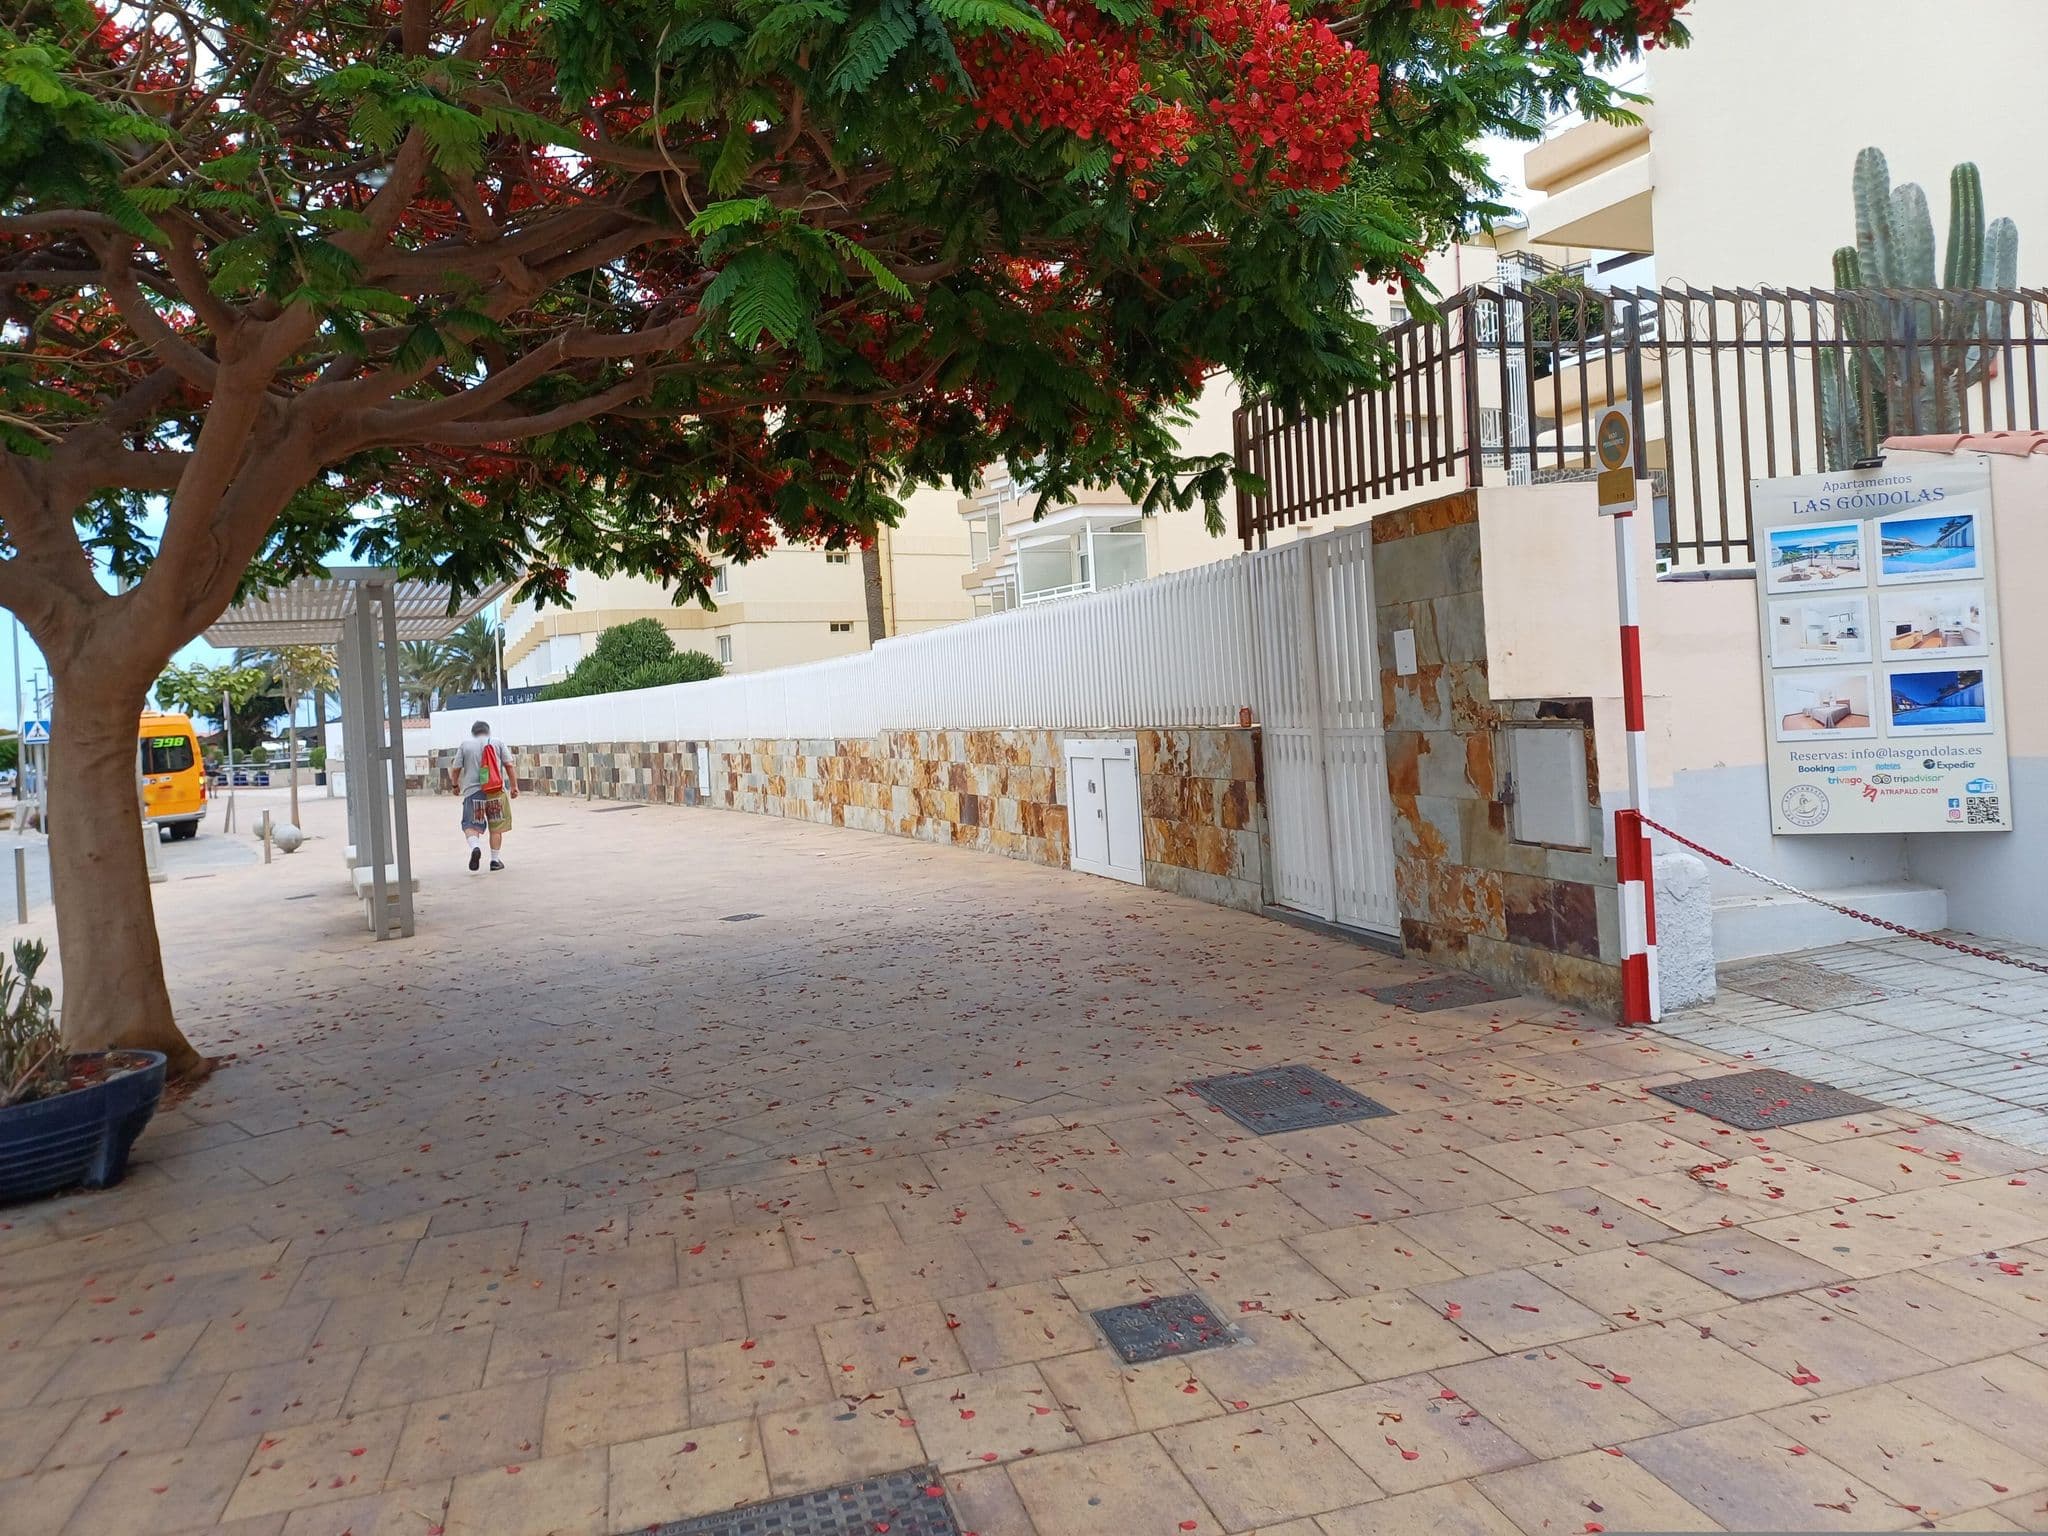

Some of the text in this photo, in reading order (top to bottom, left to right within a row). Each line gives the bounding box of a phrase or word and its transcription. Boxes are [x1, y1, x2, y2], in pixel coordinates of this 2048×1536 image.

[1822, 475, 1912, 493] Apartamentos
[1792, 498, 1831, 514] LAS
[152, 736, 185, 749] 398
[1789, 746, 1983, 761] Reservas: info@lasgondolas.es
[1827, 775, 1863, 786] trivago
[1893, 774, 1944, 784] tripadvisor
